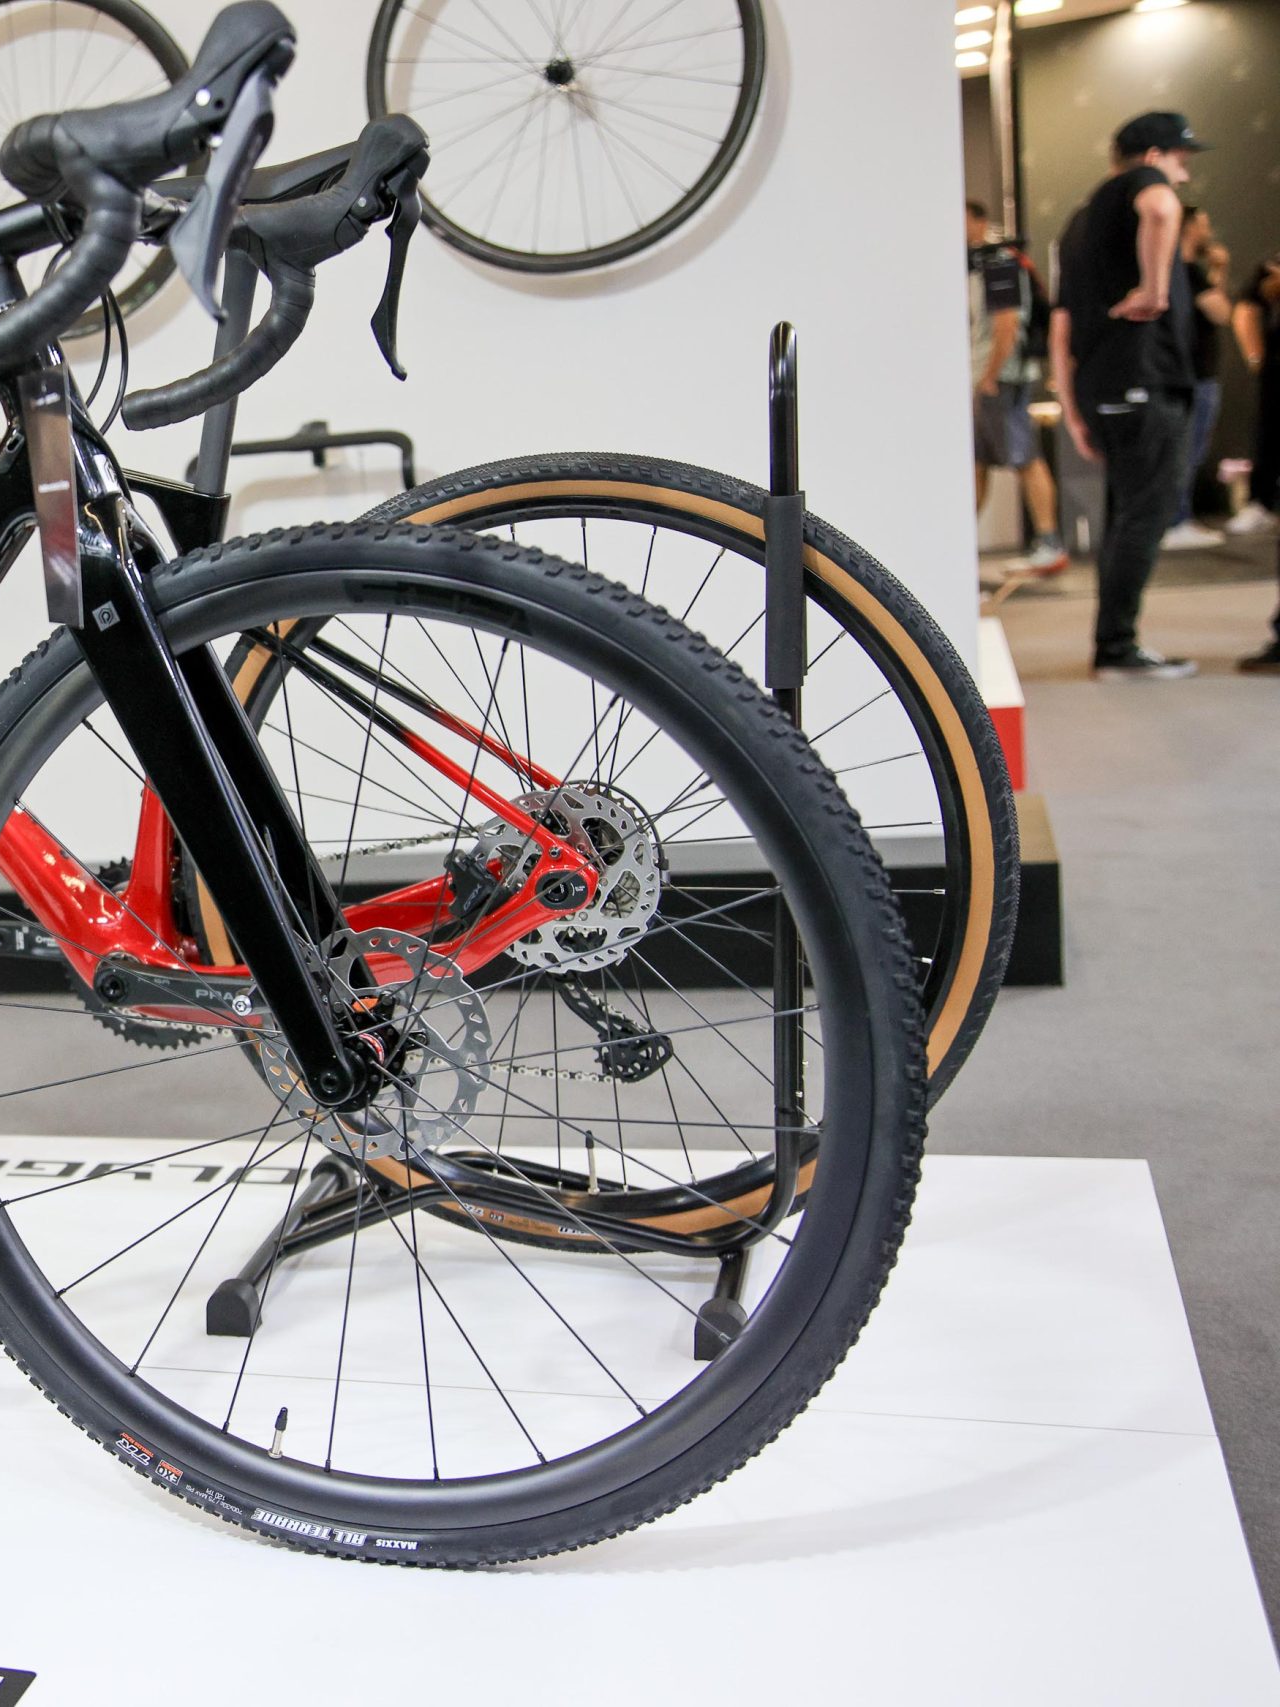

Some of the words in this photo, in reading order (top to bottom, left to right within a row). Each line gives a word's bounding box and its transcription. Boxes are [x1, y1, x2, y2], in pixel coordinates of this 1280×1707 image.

[157, 1465, 180, 1484] EXO
[251, 1507, 332, 1541] TERRANE
[333, 1528, 368, 1547] ALL
[375, 1538, 418, 1551] MAXXIS
